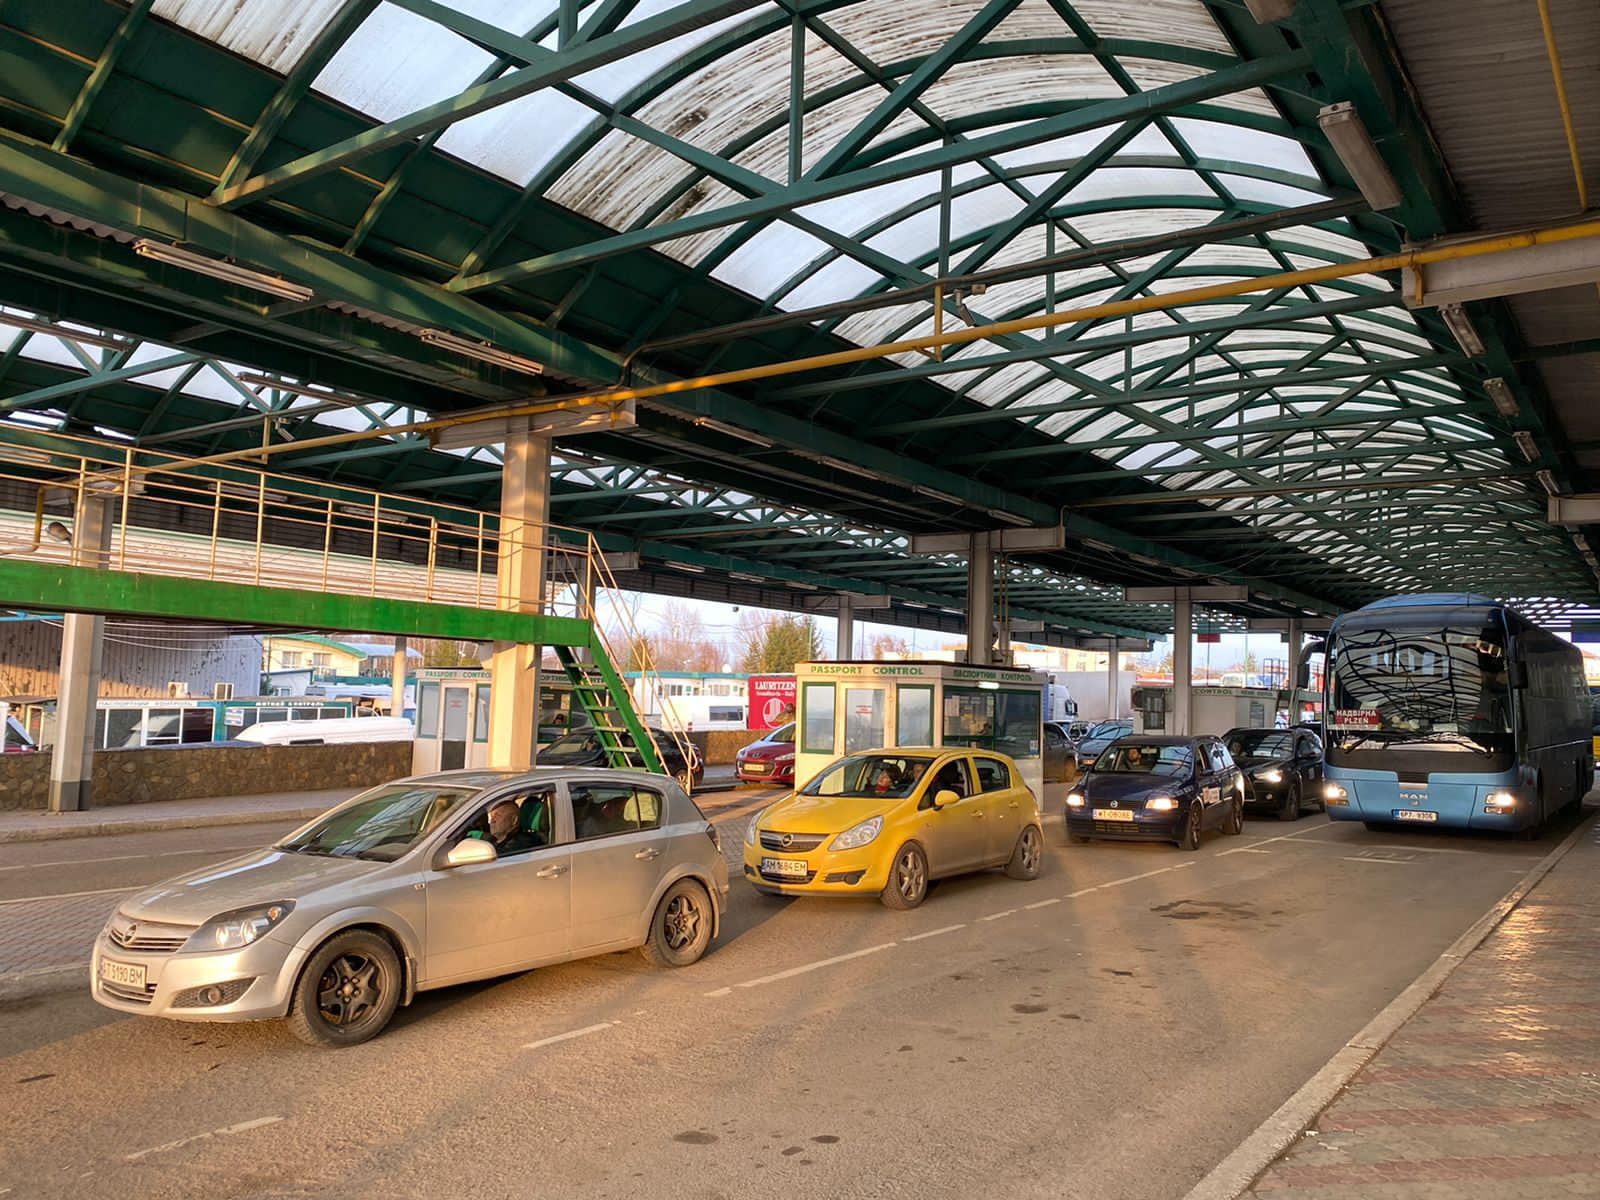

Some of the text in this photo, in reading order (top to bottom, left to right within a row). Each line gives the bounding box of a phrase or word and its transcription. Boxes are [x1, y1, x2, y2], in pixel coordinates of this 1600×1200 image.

[811, 665, 924, 675] PASSPORT CONTROL
[1399, 792, 1429, 800] MAN
